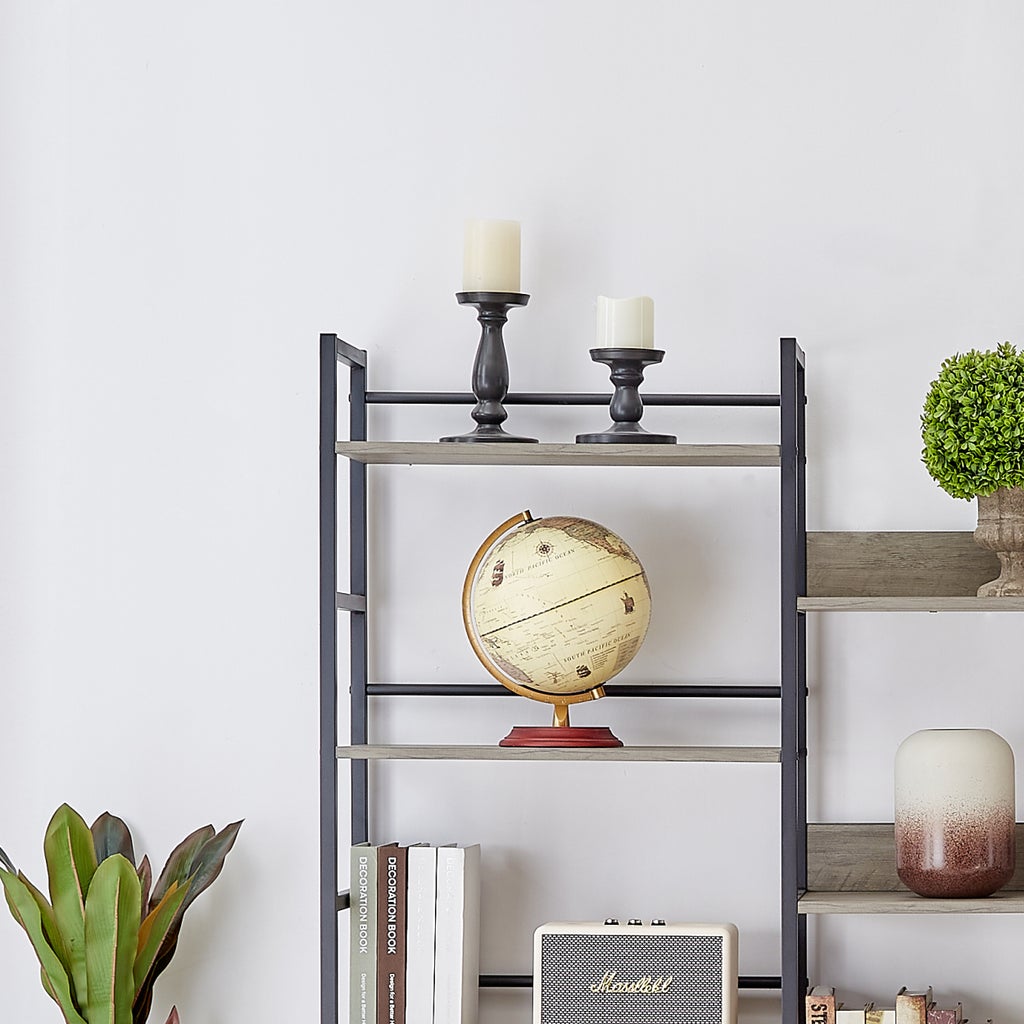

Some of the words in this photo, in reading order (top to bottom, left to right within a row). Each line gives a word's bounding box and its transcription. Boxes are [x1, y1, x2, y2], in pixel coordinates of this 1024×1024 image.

[359, 857, 368, 923] DECORATION
[387, 857, 396, 923] DECORATION
[359, 925, 368, 954] BOOK
[387, 925, 396, 954] BOOK
